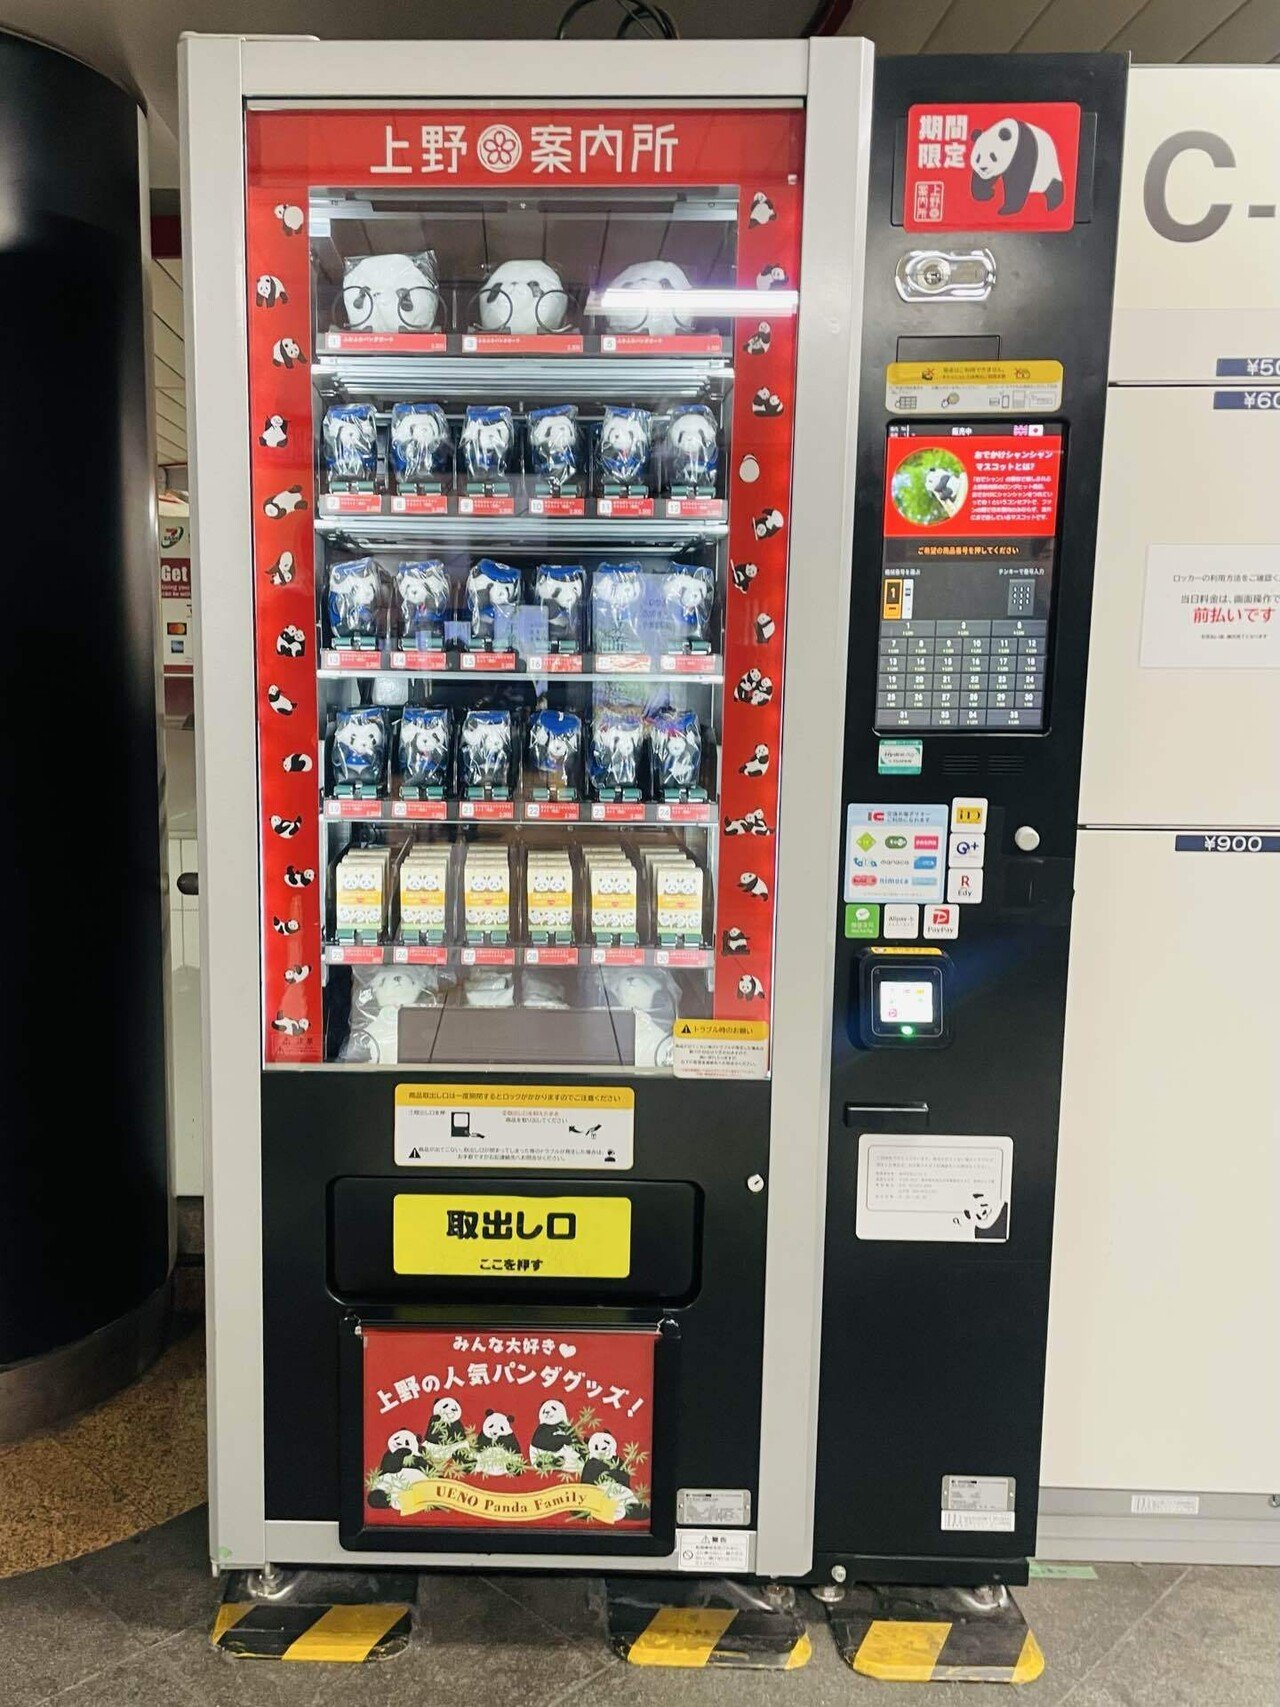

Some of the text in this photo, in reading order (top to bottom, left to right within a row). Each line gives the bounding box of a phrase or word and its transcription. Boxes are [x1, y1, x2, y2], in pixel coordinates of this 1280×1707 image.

[919, 115, 968, 141] 期間
[370, 123, 679, 174] 上野 案内所
[917, 142, 966, 169] 限定
[161, 565, 188, 582] Get
[890, 587, 896, 598] 1
[1194, 607, 1276, 623] 前払いです
[529, 805, 538, 815] 22
[1204, 835, 1262, 852] ¥900
[961, 876, 970, 887] R
[446, 1210, 577, 1240] 取出し口
[480, 1258, 543, 1271] ここを押す
[453, 1336, 556, 1355] みんな大好き
[376, 1361, 644, 1418] 上野の人気パンダグッズ!
[436, 1486, 587, 1513] UENO Panda Family
